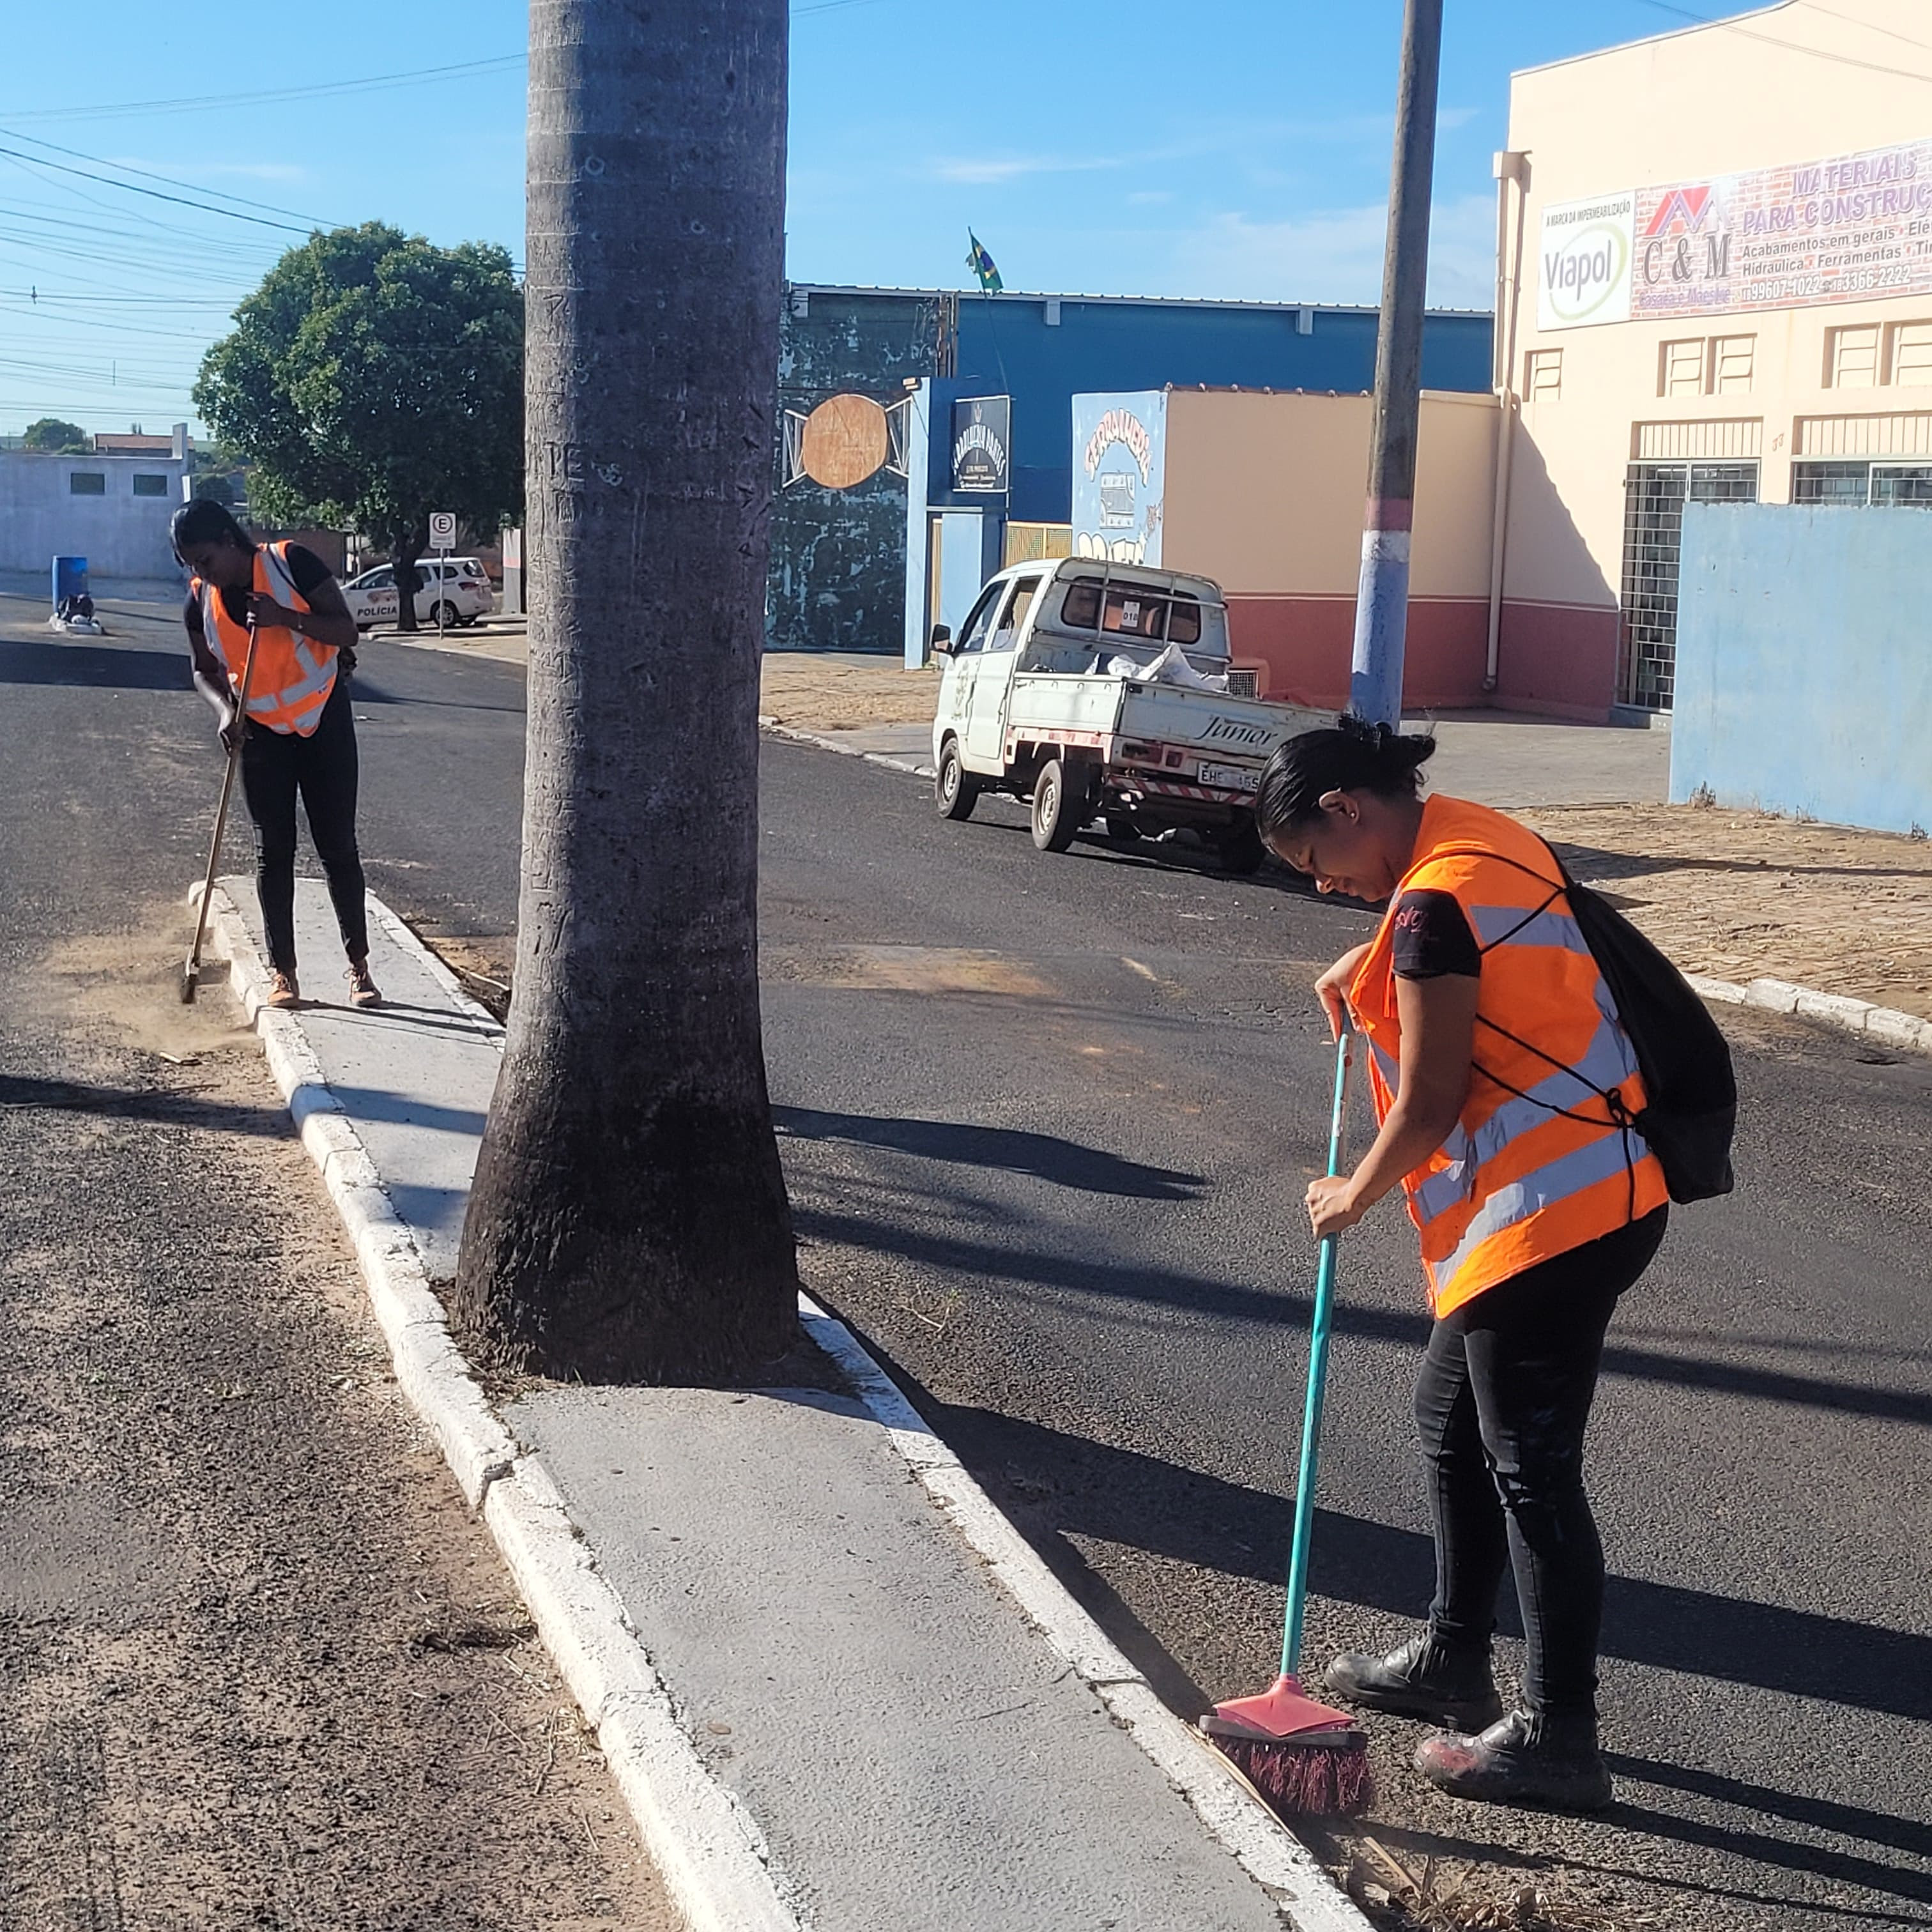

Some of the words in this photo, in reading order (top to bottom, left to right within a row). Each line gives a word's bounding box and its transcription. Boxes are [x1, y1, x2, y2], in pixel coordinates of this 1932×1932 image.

[1793, 151, 1917, 197] MATERIAIS
[1551, 211, 1568, 227] MARCA
[1569, 210, 1576, 224] DA
[1743, 204, 1797, 234] PARA
[1742, 236, 1826, 258] Acabamentos
[1830, 235, 1849, 247] em
[1853, 226, 1896, 248] gerais
[1545, 240, 1612, 302] Viapol
[1644, 240, 1663, 285] C
[1671, 238, 1693, 282] &
[1704, 233, 1732, 280] M
[1743, 257, 1804, 277] Hidraulica
[1817, 246, 1902, 268] Ferramentas
[1751, 275, 1820, 301] 99607-1022
[1842, 263, 1912, 291] 3366-2222
[438, 518, 447, 529] E
[357, 604, 397, 617] POLÍCIA
